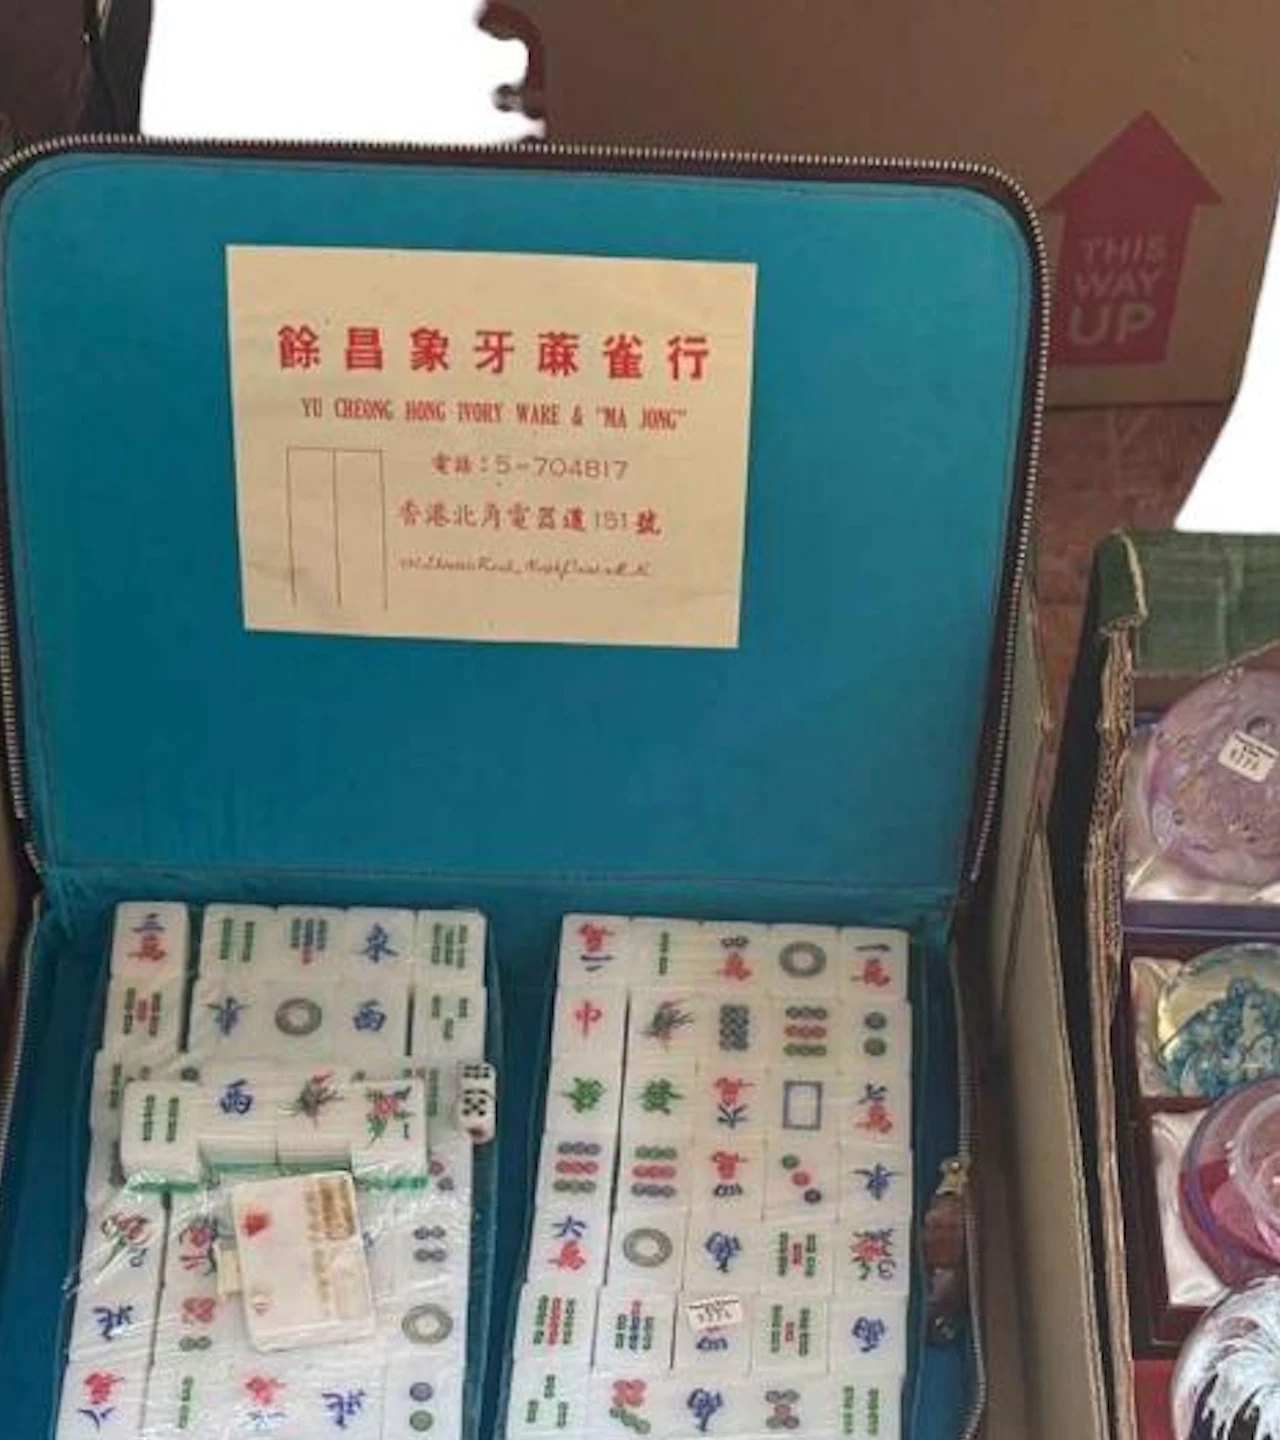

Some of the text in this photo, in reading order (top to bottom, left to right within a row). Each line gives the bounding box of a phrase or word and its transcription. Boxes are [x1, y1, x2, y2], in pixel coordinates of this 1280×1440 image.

[1080, 234, 1168, 264] THIS
[1075, 268, 1161, 298] WAY
[1070, 302, 1156, 346] UP
[300, 397, 322, 418] YU
[333, 398, 394, 421] CHEONG
[404, 399, 447, 421] HONG
[457, 401, 503, 424] IVORY
[515, 403, 562, 426] WARE
[571, 405, 584, 427] &
[574, 1000, 602, 1035] 中
